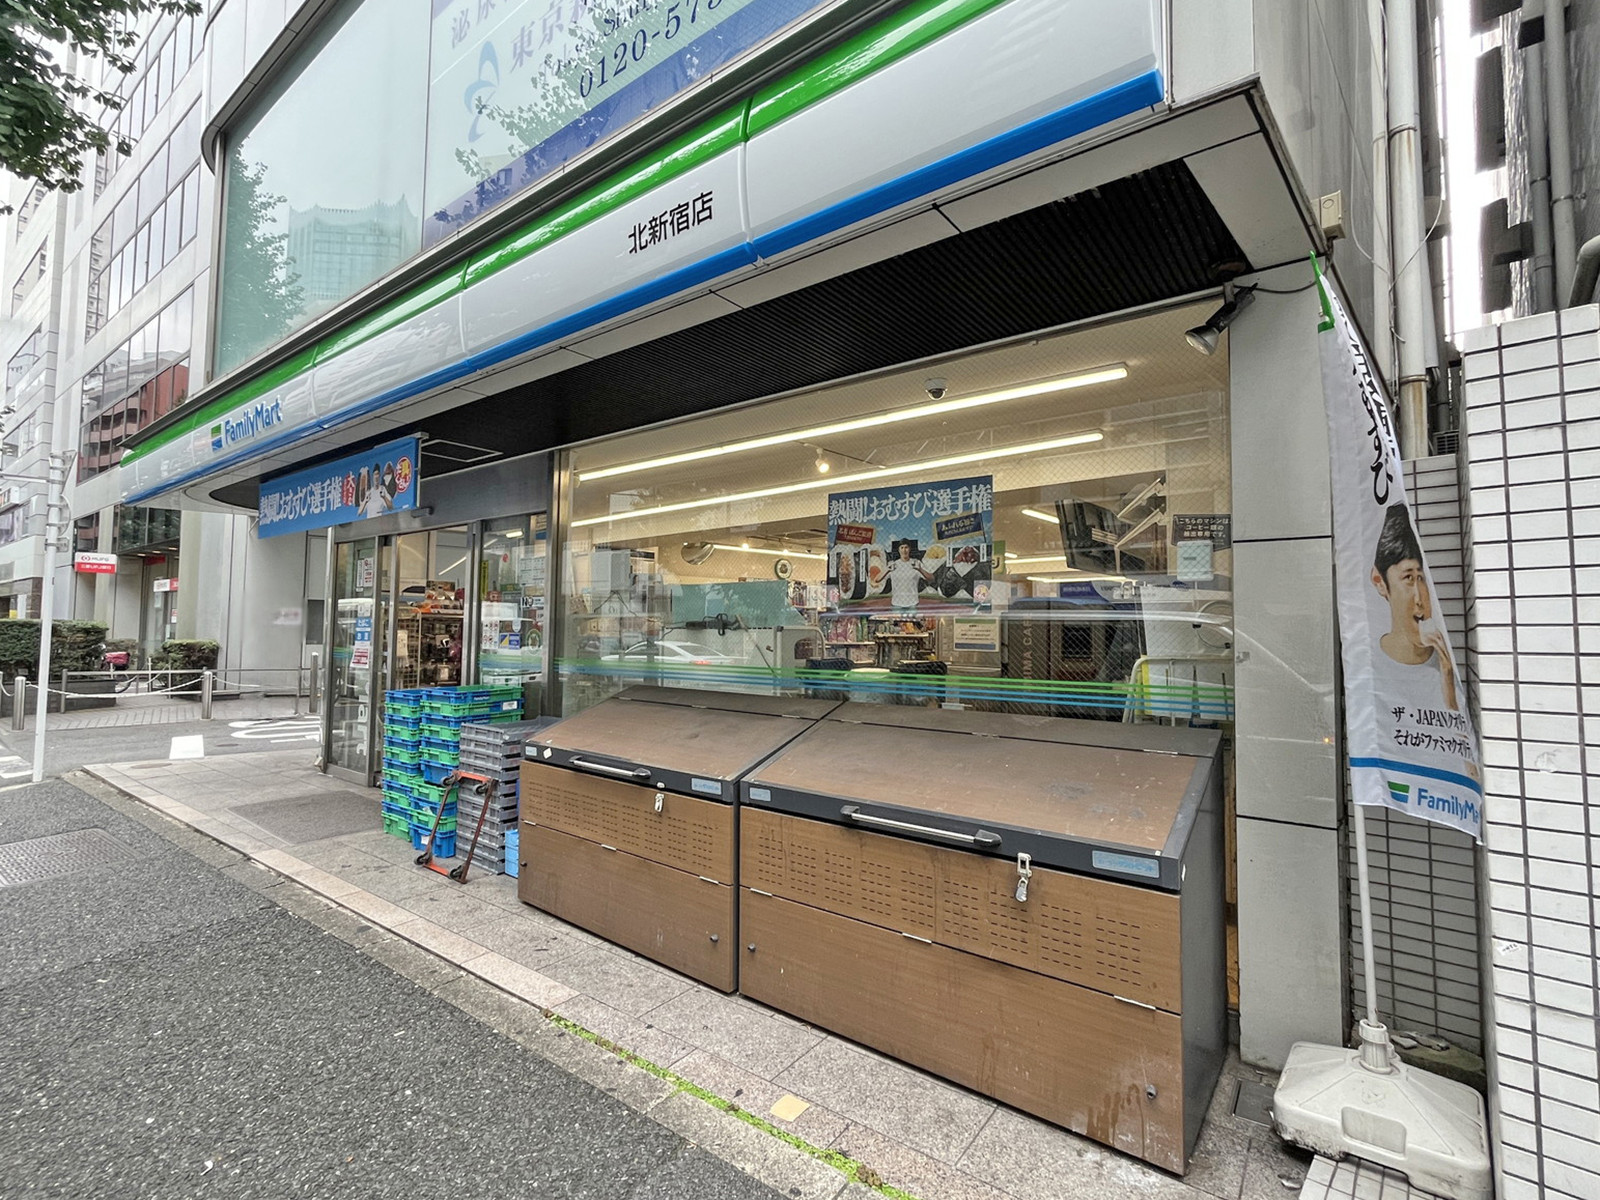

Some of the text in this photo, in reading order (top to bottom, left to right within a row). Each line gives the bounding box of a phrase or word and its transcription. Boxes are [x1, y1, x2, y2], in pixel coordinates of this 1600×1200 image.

[628, 191, 713, 254] 北新宿店
[225, 397, 283, 444] FamilyMart
[1417, 787, 1479, 824] FamilyMa
